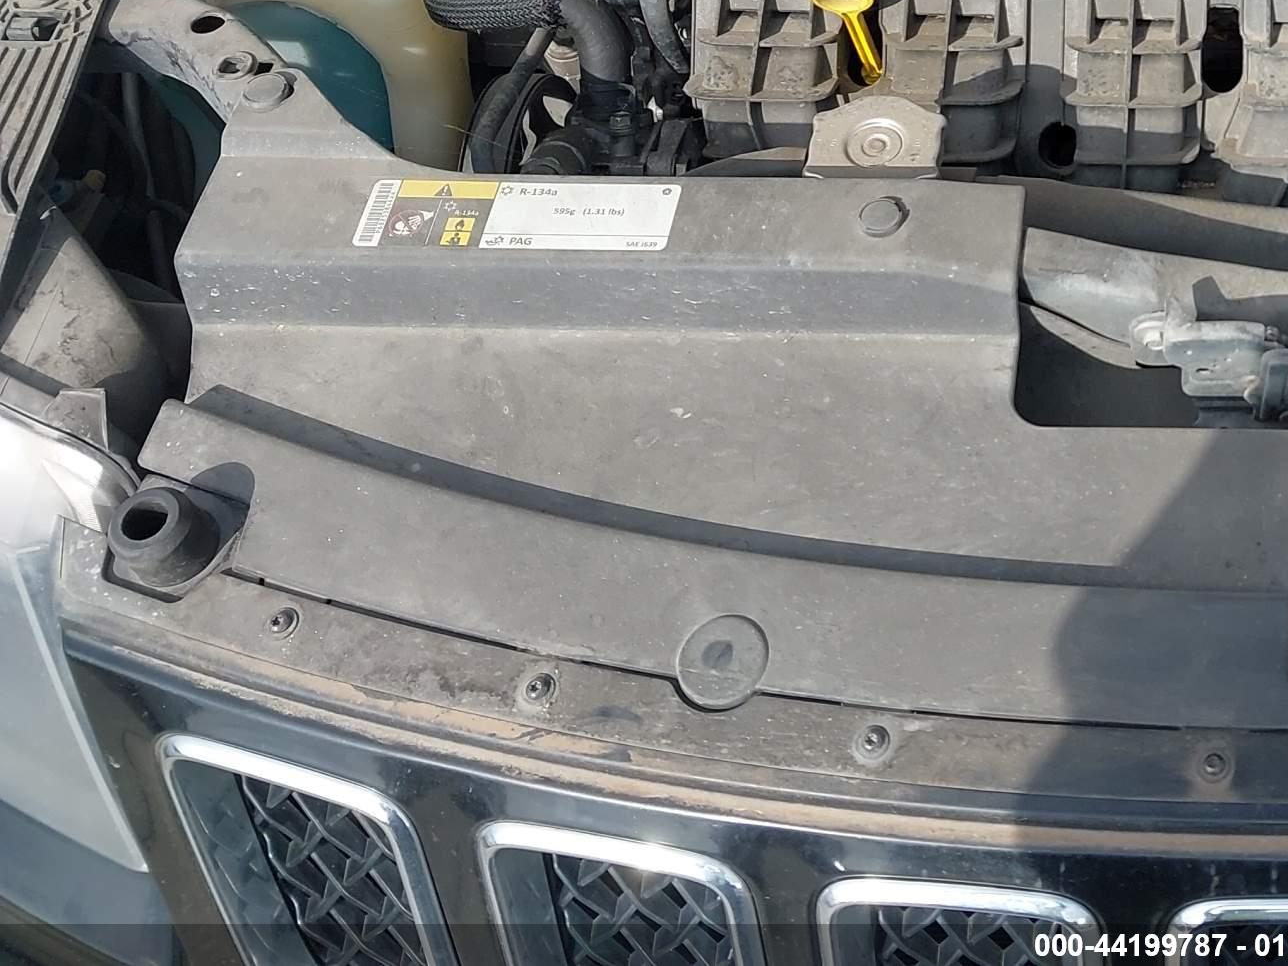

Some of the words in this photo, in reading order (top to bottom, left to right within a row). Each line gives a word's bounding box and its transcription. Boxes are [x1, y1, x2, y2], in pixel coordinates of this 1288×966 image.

[519, 187, 558, 196] R-134a
[553, 207, 576, 216] 595g
[582, 208, 605, 216] (1.31
[608, 208, 625, 216] lbs)
[509, 237, 533, 246] PAG
